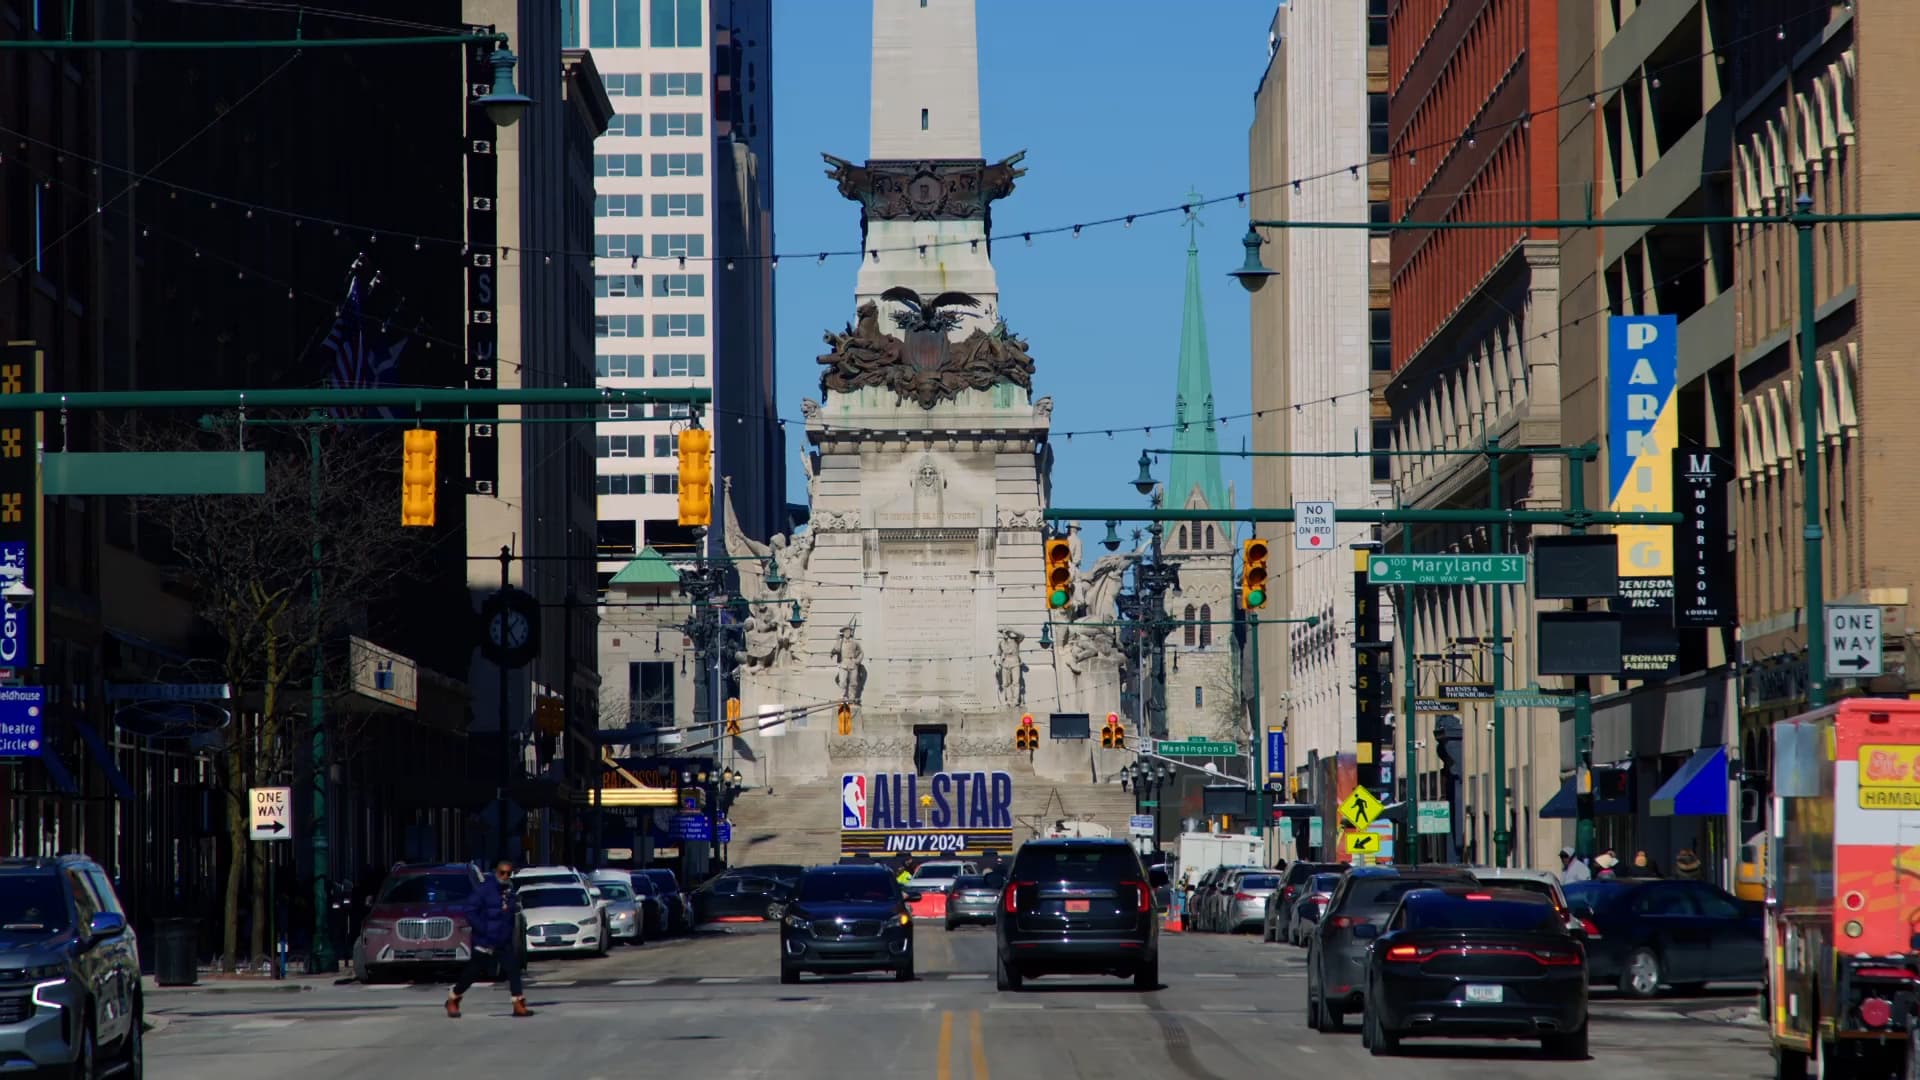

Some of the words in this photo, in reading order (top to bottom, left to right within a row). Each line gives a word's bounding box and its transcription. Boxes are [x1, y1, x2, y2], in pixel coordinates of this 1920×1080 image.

[1627, 323, 1661, 569] PARKING
[1306, 505, 1323, 515] NO
[1304, 516, 1327, 525] TURN
[1299, 526, 1312, 535] ON
[1314, 525, 1331, 535] RED
[1694, 489, 1707, 606] MORRISON
[1390, 559, 1407, 567] 100
[1412, 558, 1492, 575] Maryland
[1501, 558, 1518, 572] St
[1395, 570, 1401, 580] S
[0, 549, 17, 661] Cenir
[1632, 598, 1660, 608] INC.
[1835, 614, 1874, 630] ONE
[1833, 636, 1876, 651] WAY
[1623, 662, 1669, 670] PARKING
[1500, 697, 1560, 706] MARYLAND
[1161, 744, 1219, 755] Washington
[1223, 744, 1233, 753] St
[257, 791, 283, 803] ONE
[871, 773, 923, 829] ALL
[931, 772, 1012, 828] STAR
[258, 806, 284, 817] WAY
[887, 835, 927, 851] INDY
[930, 835, 965, 850] 2024
